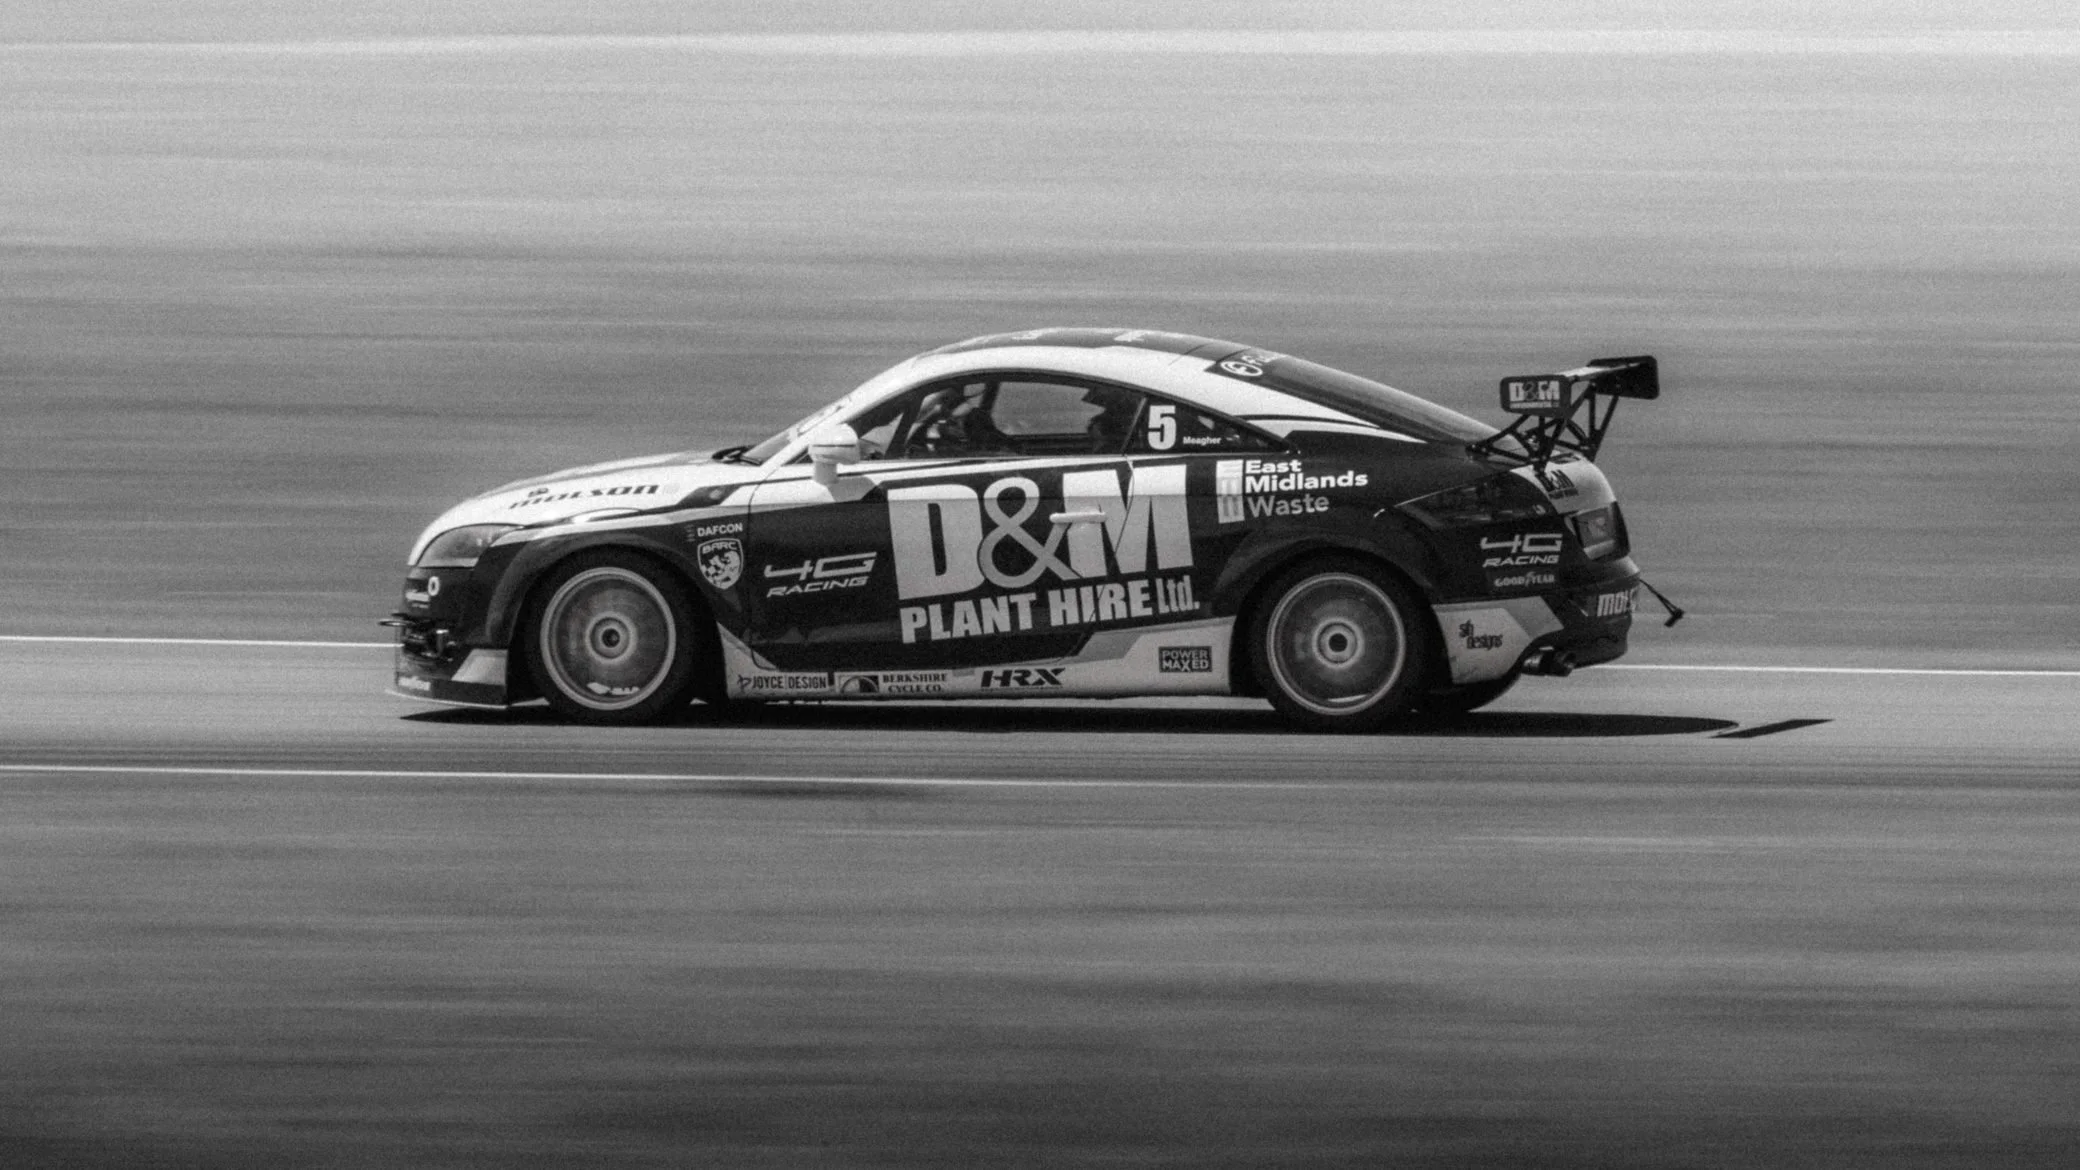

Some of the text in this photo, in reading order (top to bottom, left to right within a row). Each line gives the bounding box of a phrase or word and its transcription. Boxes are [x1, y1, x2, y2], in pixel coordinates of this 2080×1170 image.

[1147, 404, 1177, 450] 5
[1182, 435, 1222, 446] Meagher
[1245, 459, 1302, 474] East
[1245, 470, 1368, 494] Midlands
[1247, 493, 1330, 518] Waste
[697, 522, 743, 537] DAFCON
[887, 463, 1195, 600] D&M
[702, 541, 738, 555] BARC
[1480, 533, 1563, 554] 4G
[763, 552, 877, 581] 4G
[1481, 554, 1560, 568] RACING
[766, 576, 869, 598] RACING
[900, 575, 1200, 644] PLANT HIRE Ltd.
[1162, 649, 1208, 660] POWER
[1162, 659, 1209, 672] MAXED
[752, 675, 827, 690] JOYCE DESIGN
[882, 673, 947, 683] BERKSHIRE
[981, 667, 1066, 687] HRX
[888, 684, 922, 693] CYCLE
